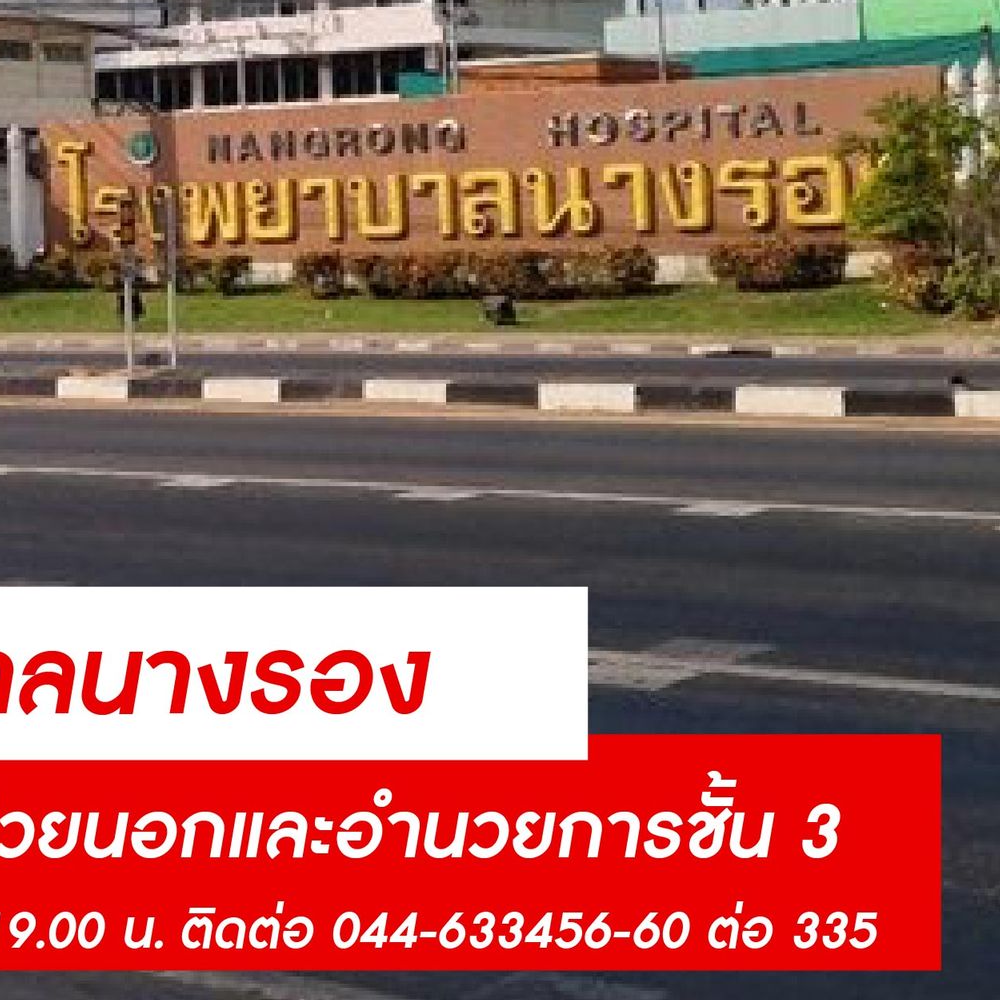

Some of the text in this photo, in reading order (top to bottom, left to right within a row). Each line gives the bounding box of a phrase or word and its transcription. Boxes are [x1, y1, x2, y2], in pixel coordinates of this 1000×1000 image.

[207, 99, 824, 164] NANGRONG HOSPITAL
[57, 141, 888, 246] โรงพยาบาลนางรอ
